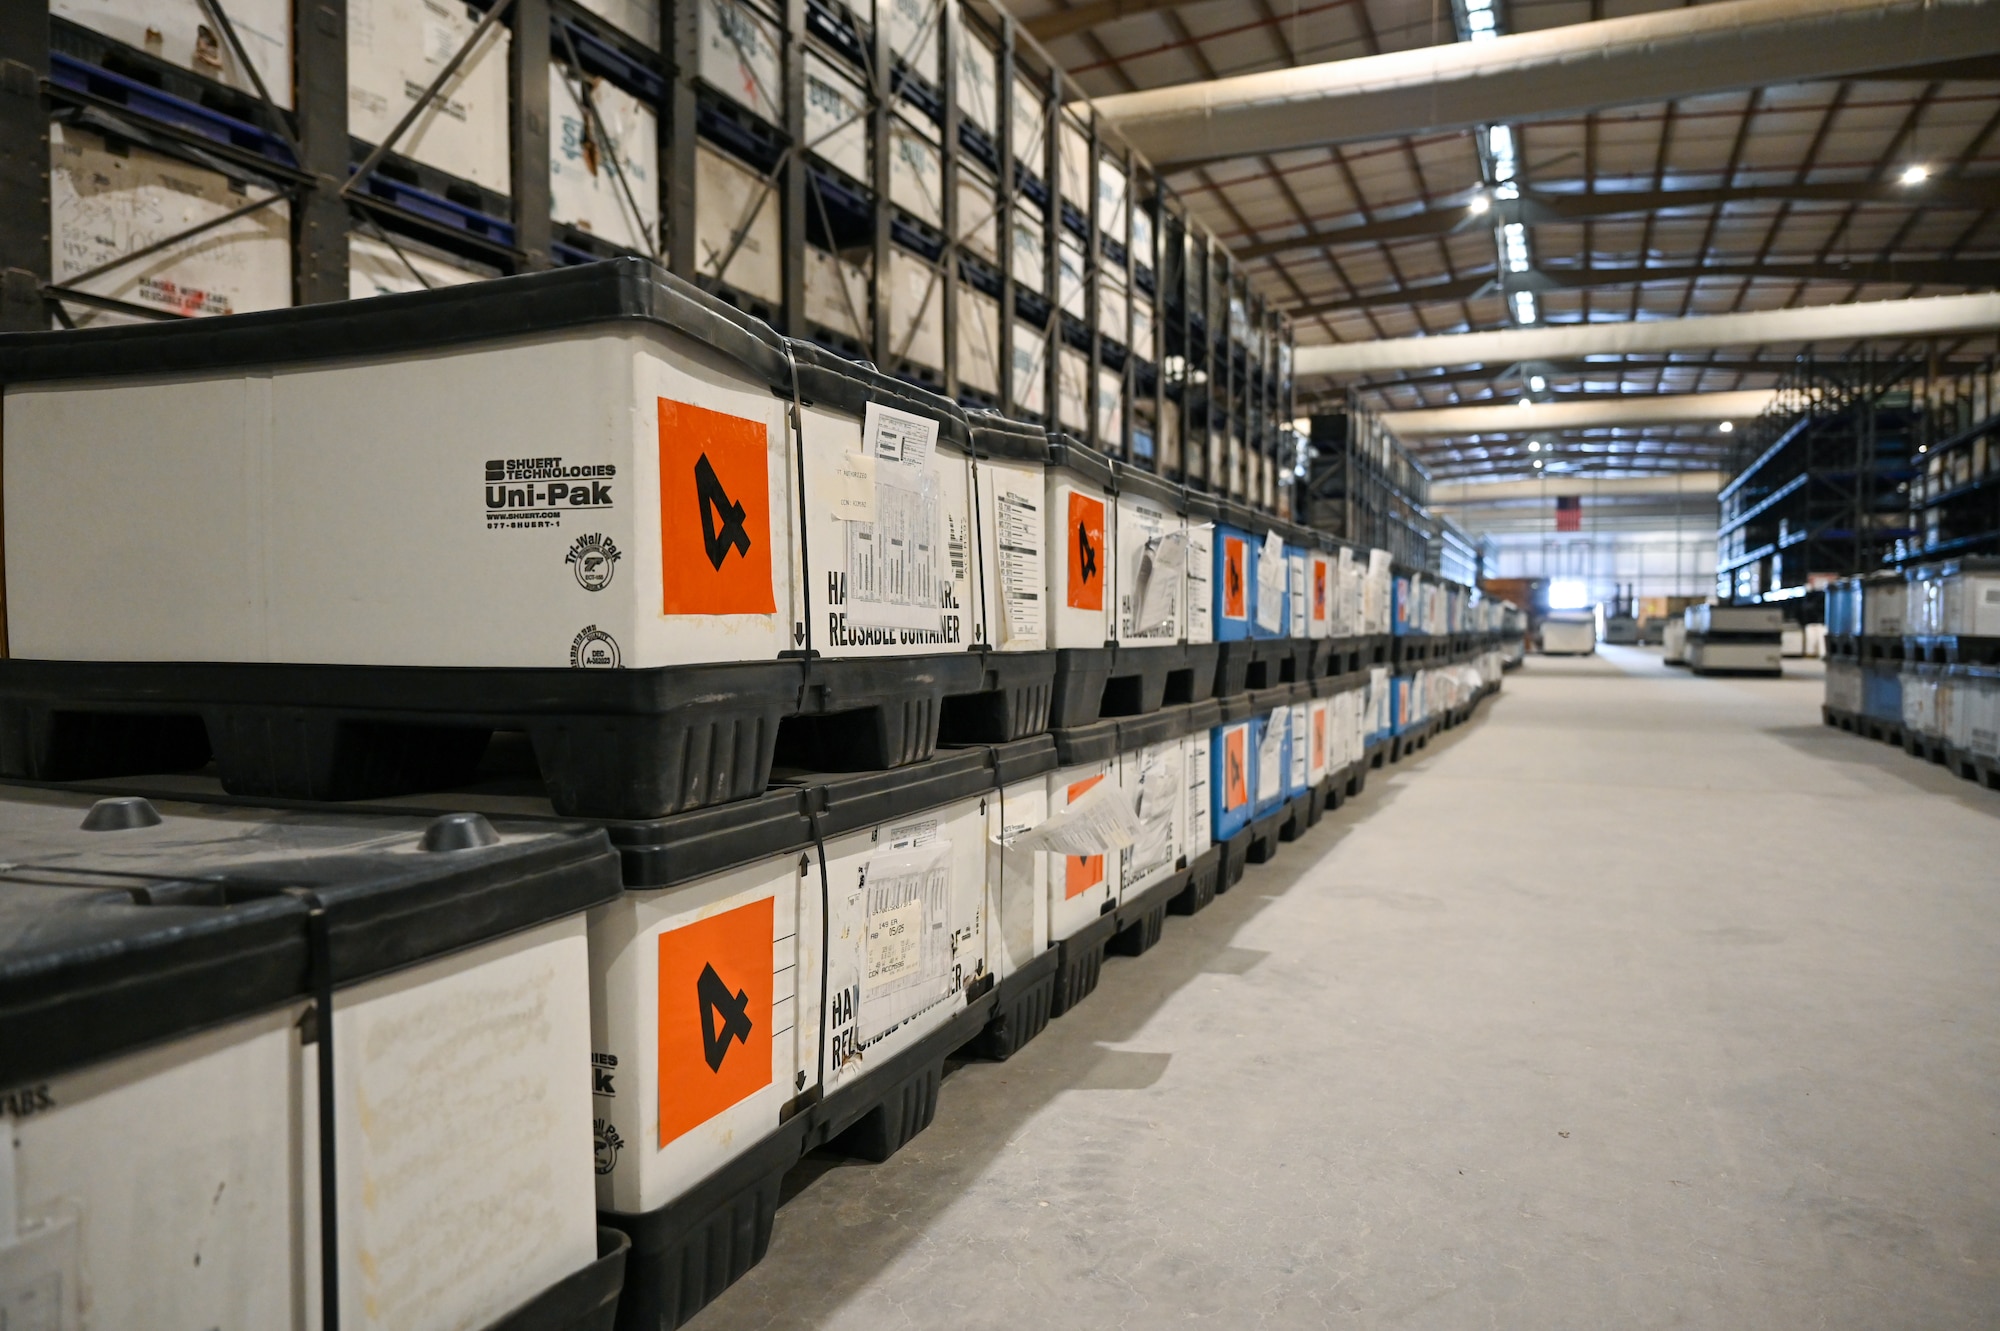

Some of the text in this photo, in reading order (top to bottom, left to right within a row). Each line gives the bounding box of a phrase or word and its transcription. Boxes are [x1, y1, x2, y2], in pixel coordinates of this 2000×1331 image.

[506, 457, 562, 471] SHUERT
[506, 464, 617, 480] TECHNOLOGIES
[485, 481, 613, 509] Uni-Pak
[486, 511, 560, 521] WWW.SHUERT.COM
[694, 452, 751, 572] 4
[602, 536, 622, 563] Pak
[1079, 520, 1097, 585] 4
[697, 961, 753, 1074] 4
